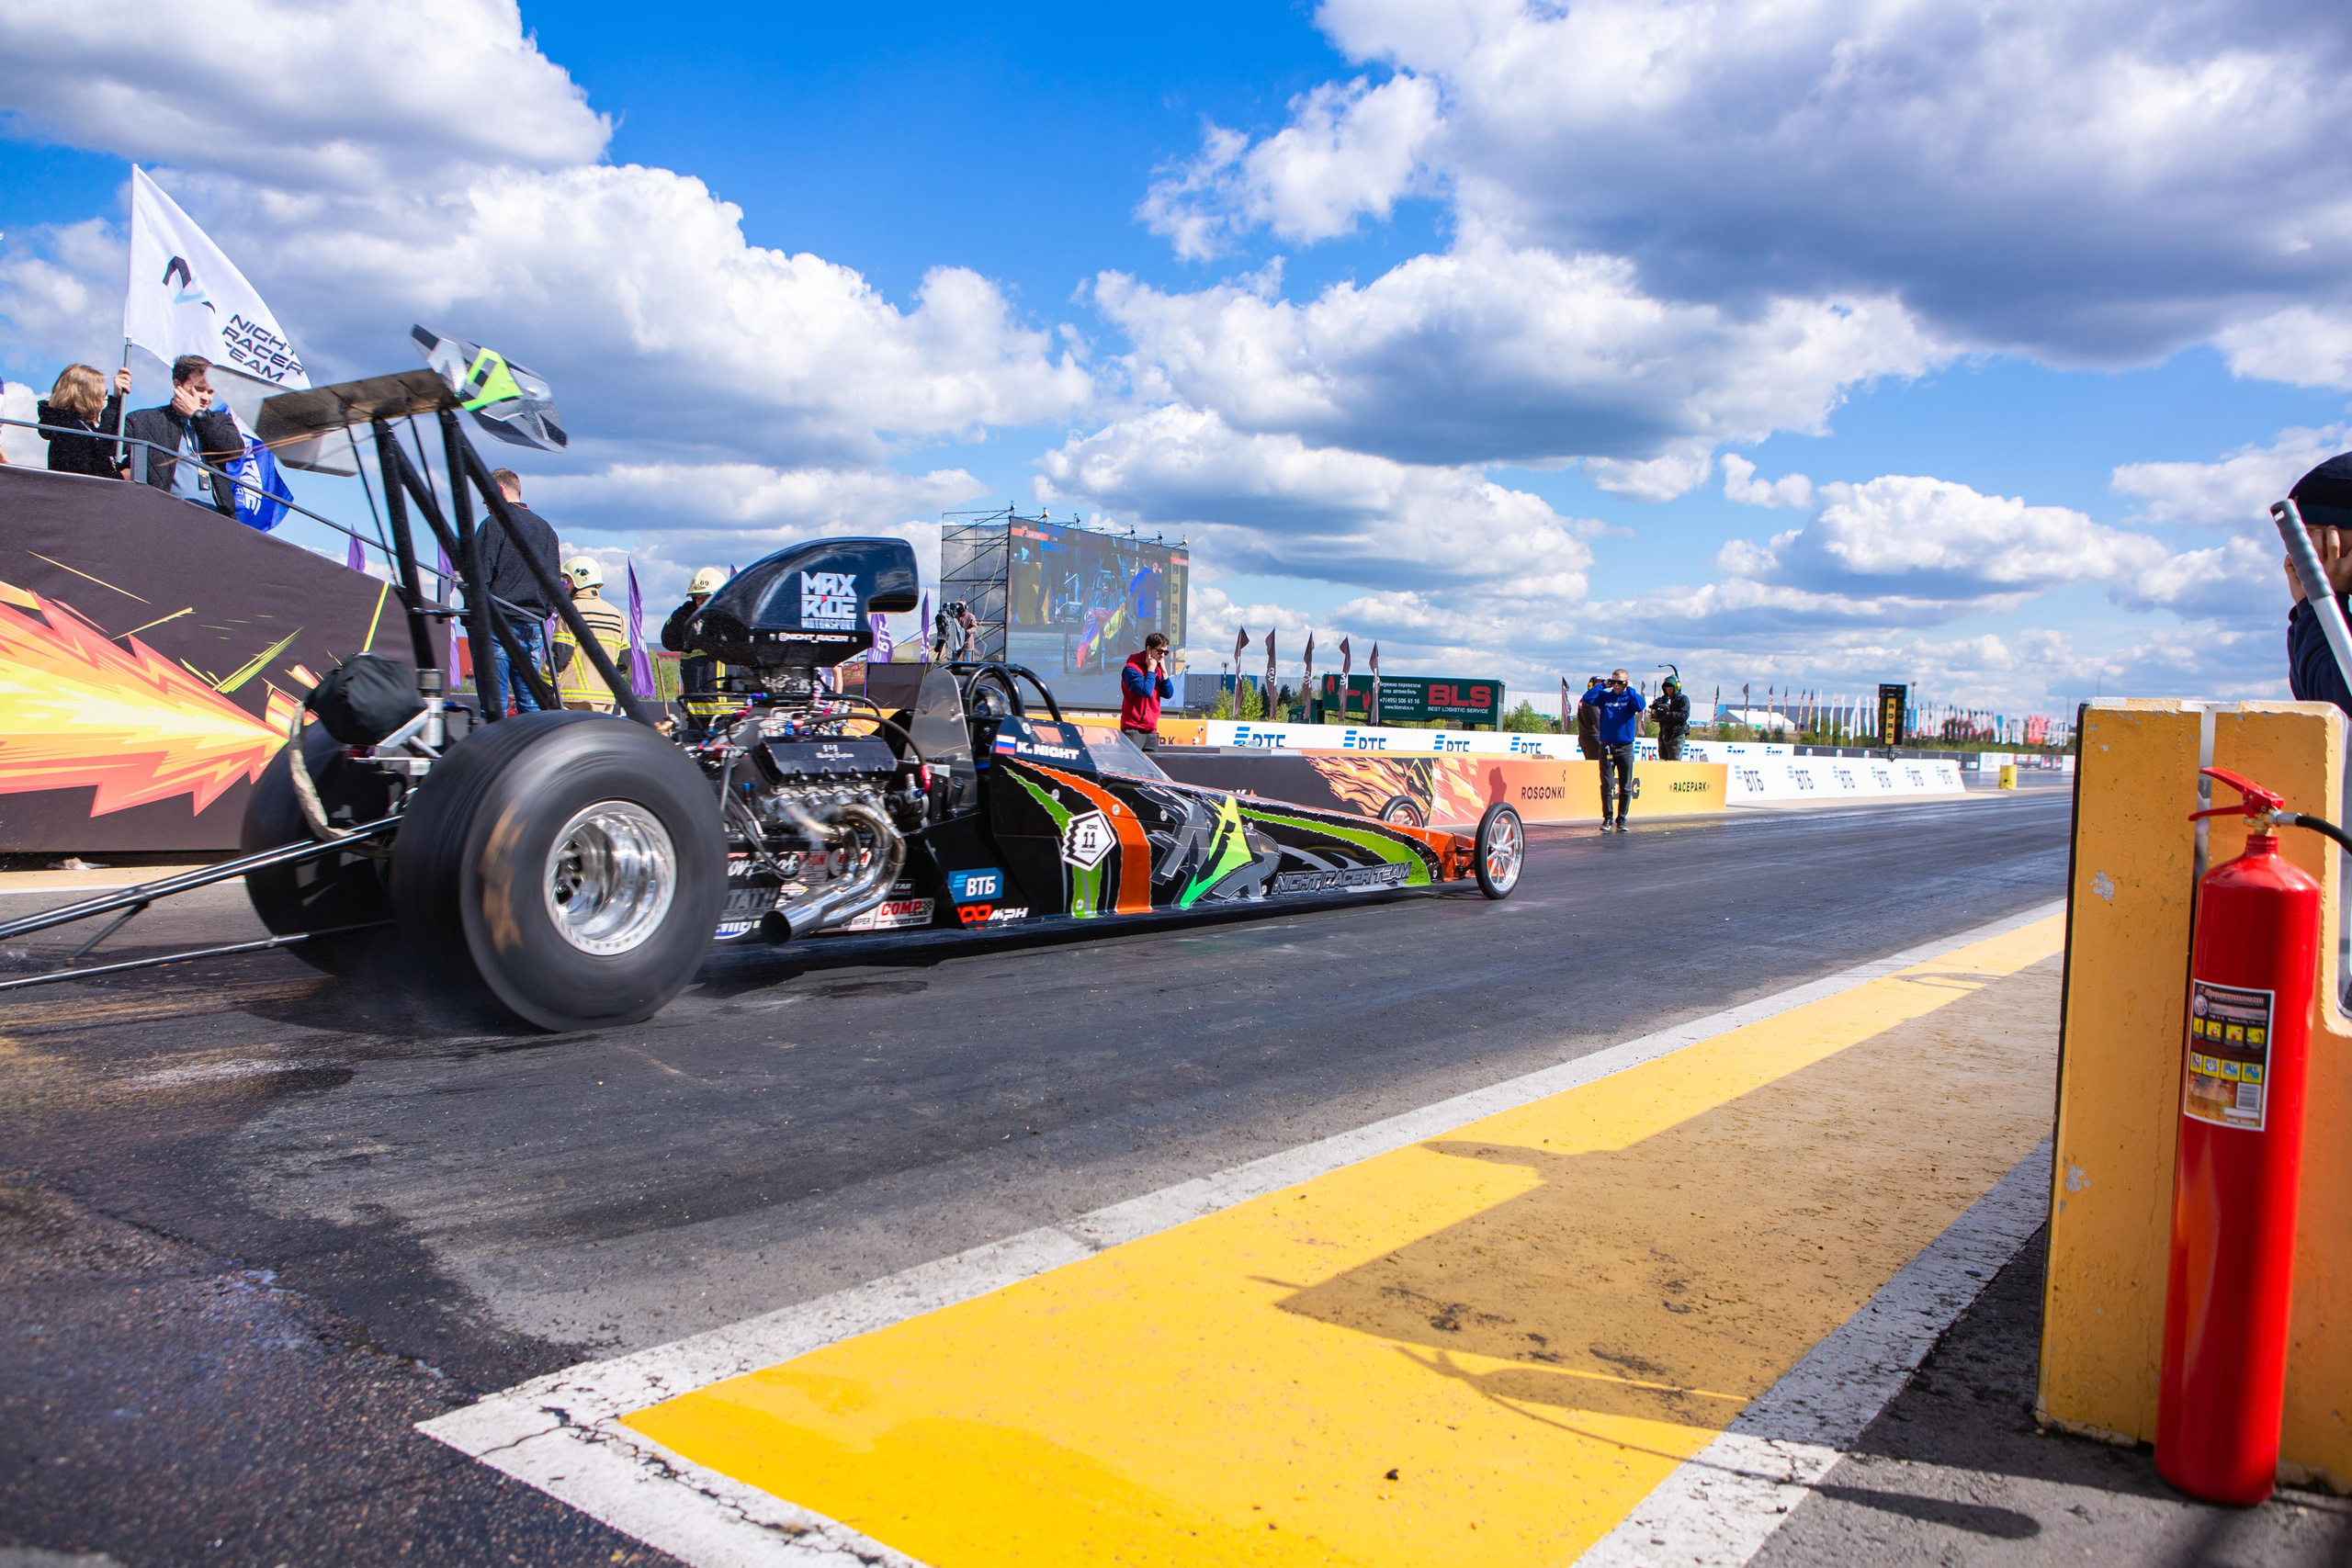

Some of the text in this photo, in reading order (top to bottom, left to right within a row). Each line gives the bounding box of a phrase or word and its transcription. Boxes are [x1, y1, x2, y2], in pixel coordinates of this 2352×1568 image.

[800, 570, 857, 597] MAX
[1428, 684, 1492, 708] BLS
[1033, 744, 1080, 760] NIGHT
[1672, 781, 1708, 794] RACEPARK
[1743, 770, 1764, 792] ВТБ
[1794, 770, 1814, 790] ВТБ
[1521, 785, 1566, 800] ROSGONKI
[1081, 831, 1096, 849] 11
[966, 875, 997, 897] ВТБ
[1272, 862, 1412, 894] NIGHT RACER TEAM
[881, 900, 922, 916] COMP
